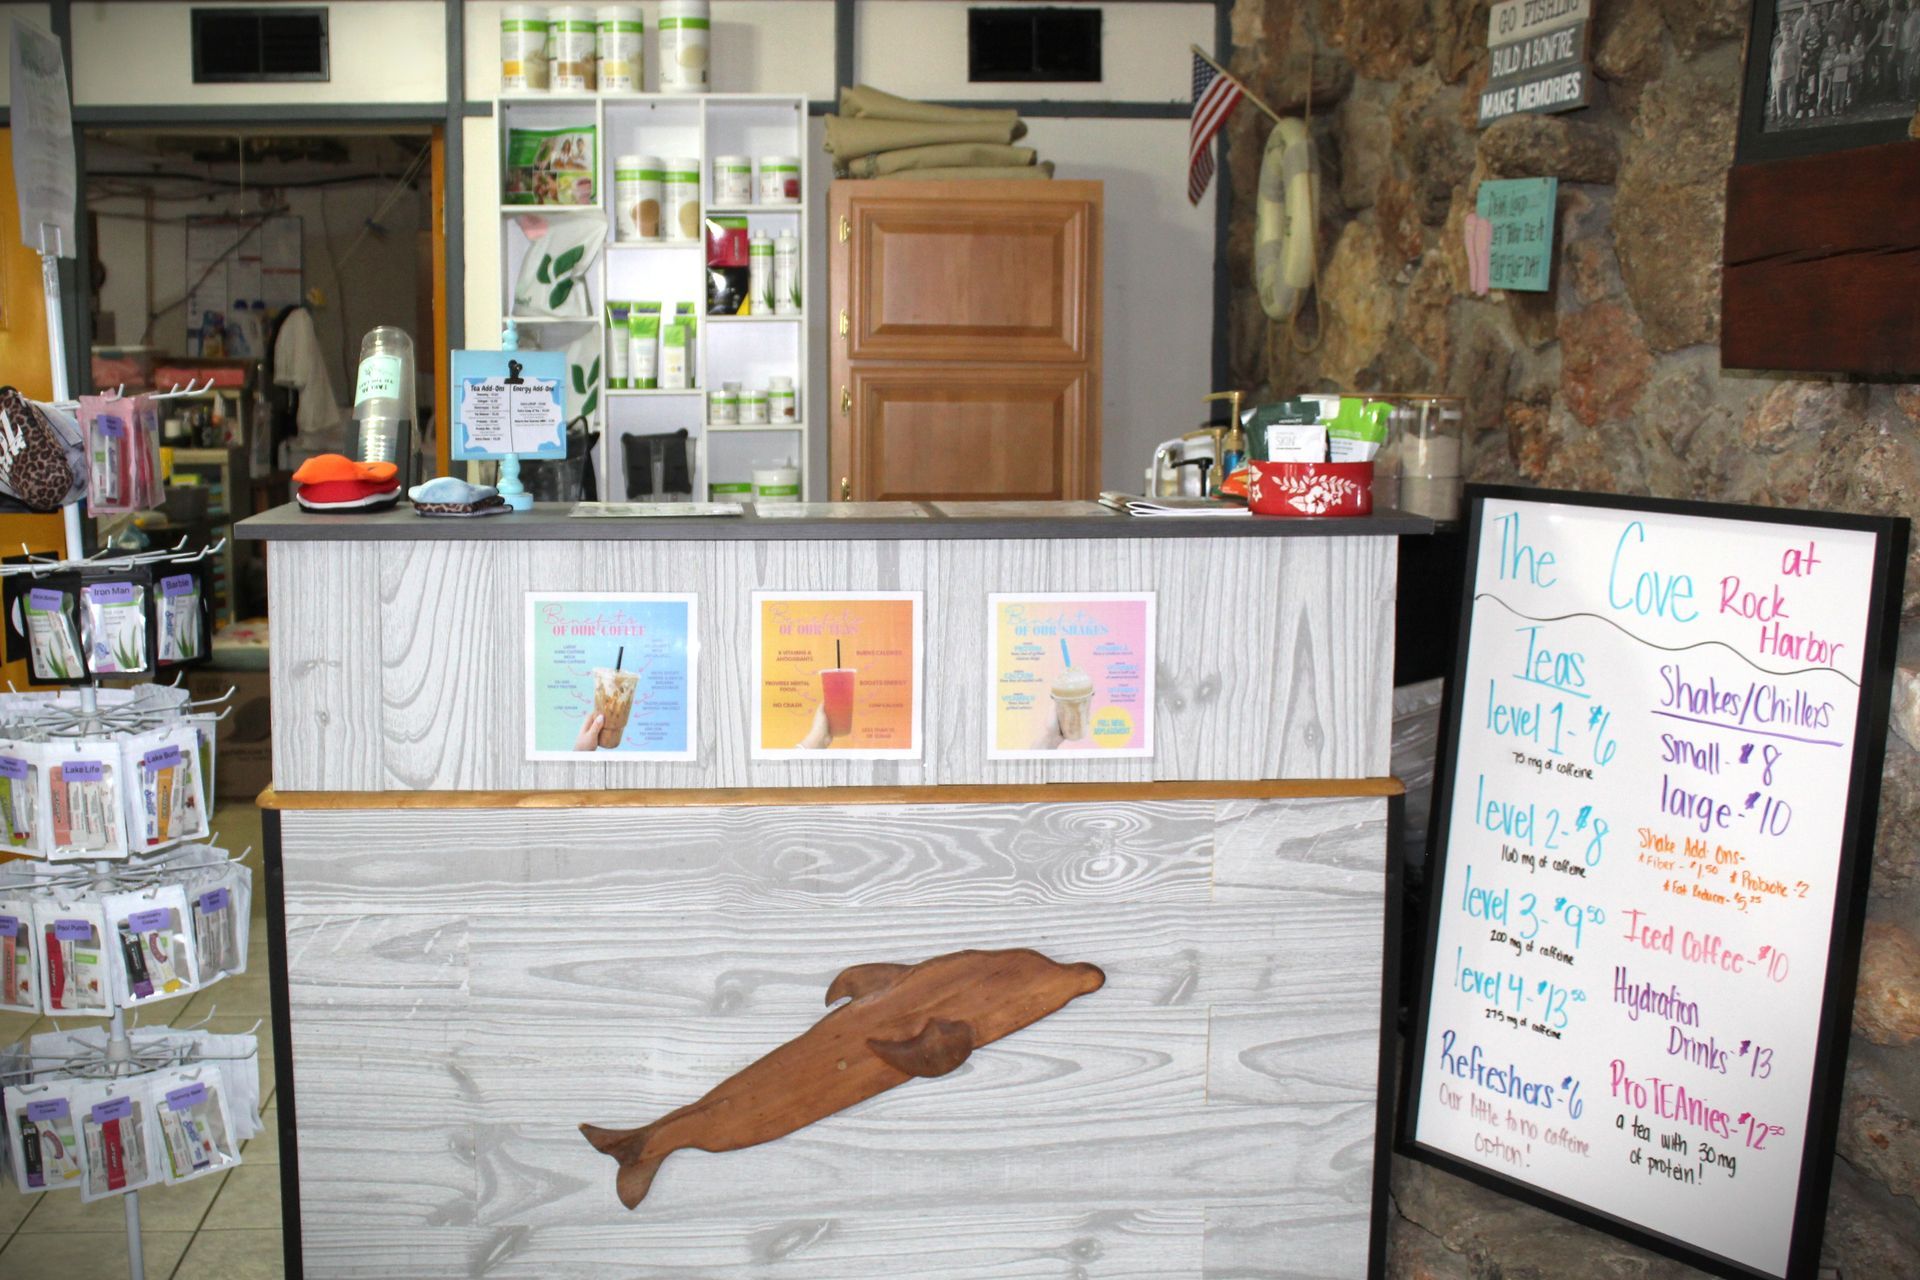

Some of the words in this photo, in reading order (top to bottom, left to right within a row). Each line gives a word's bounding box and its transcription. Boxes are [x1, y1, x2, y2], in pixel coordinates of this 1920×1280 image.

[1500, 6, 1516, 34] GO
[1492, 45, 1520, 77] BUILD
[1521, 41, 1531, 70] A
[1532, 27, 1575, 67] BONFIRE
[1481, 88, 1515, 119] MAKE
[1516, 71, 1581, 112] MEMORIES
[513, 385, 531, 393] Energy
[1493, 512, 1557, 588] The
[1609, 521, 1699, 623] Cove
[1782, 541, 1821, 577] at
[94, 587, 110, 596] Iron
[112, 586, 129, 594] Man
[165, 579, 189, 590] Barbie
[1719, 576, 1789, 622] Rock
[553, 625, 566, 636] OF
[571, 625, 595, 636] OUR
[1759, 621, 1844, 667] Harbor
[1514, 626, 1586, 688] Teas
[1487, 679, 1541, 743] level
[147, 755, 162, 763] Lake
[1528, 756, 1542, 774] mg
[1545, 758, 1552, 769] of
[1476, 774, 1535, 846] level
[1638, 827, 1675, 853] Shake
[1521, 854, 1535, 873] mg
[1539, 855, 1548, 867] of
[1462, 864, 1508, 927] level
[1672, 880, 1687, 895] Fat
[1742, 870, 1788, 897] Probiotic
[1490, 929, 1507, 942] 200
[1509, 936, 1522, 957] mg
[1525, 940, 1534, 952] of
[1539, 944, 1574, 966] caffeine
[1621, 909, 1674, 955] Iced
[1454, 946, 1501, 1006] level
[1614, 965, 1699, 1027] Hydration
[1485, 1008, 1504, 1022] 275
[1507, 1014, 1518, 1029] mg
[1520, 1017, 1527, 1026] of
[1439, 1082, 1463, 1111] Our
[1471, 1092, 1499, 1127] little
[1505, 1110, 1517, 1132] to
[1520, 1119, 1538, 1139] no
[1544, 1128, 1590, 1157] caffeine
[1616, 1114, 1625, 1130] a
[1632, 1115, 1651, 1143] tea
[1661, 1132, 1687, 1156] with
[1629, 1148, 1642, 1165] of
